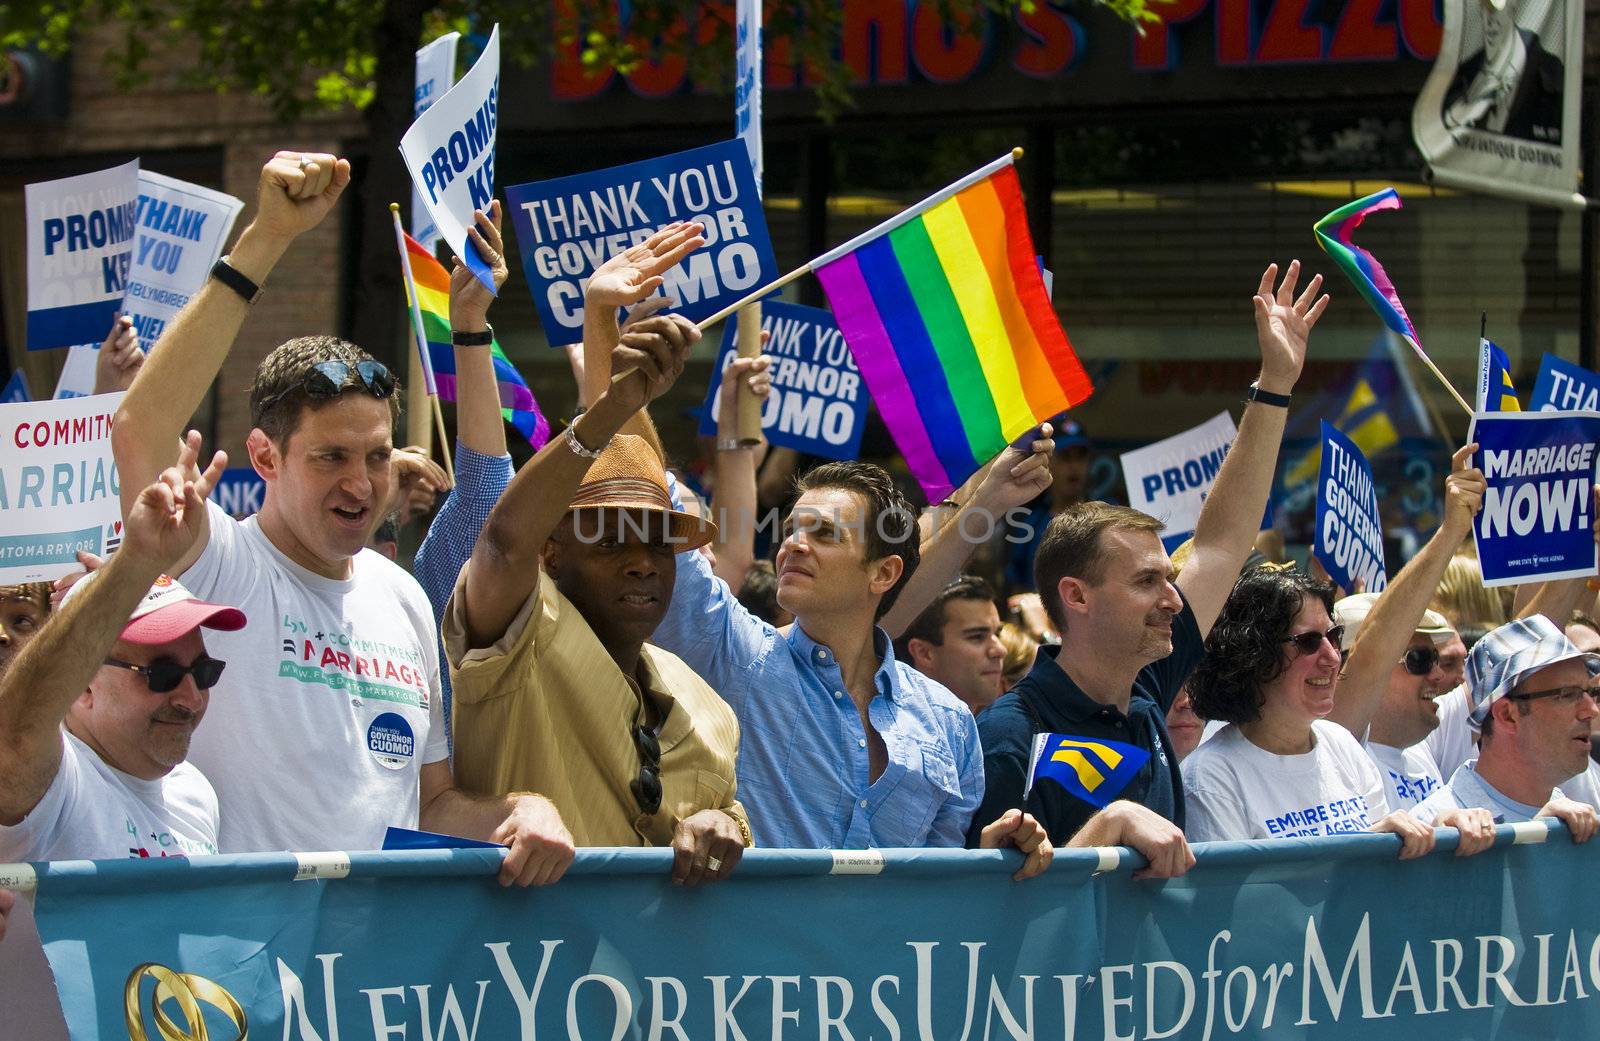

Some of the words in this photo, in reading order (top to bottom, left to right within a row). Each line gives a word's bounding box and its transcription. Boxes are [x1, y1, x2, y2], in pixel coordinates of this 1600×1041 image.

[421, 73, 498, 205] PROMIS
[467, 148, 496, 210] KE
[521, 181, 650, 243] THANK
[651, 160, 738, 217] YOU
[44, 199, 136, 256] PROMIS
[134, 194, 208, 242] THANK
[534, 206, 749, 280] GOVEROR
[136, 235, 184, 275] YOU
[547, 242, 761, 328] CMO
[732, 315, 810, 358] ANK
[722, 350, 860, 402] ERNOR
[711, 385, 855, 446] OMO
[1328, 438, 1372, 515] THANK
[1484, 443, 1595, 478] MARRIAGE
[1326, 477, 1385, 569] GOVERNO
[1481, 478, 1589, 540] NOW!
[303, 639, 425, 687] MARRIAGE
[370, 731, 412, 745] GOVERNOR
[370, 739, 412, 756] CUOMO!
[371, 725, 388, 733] THANK
[1265, 805, 1329, 834] EMPIRE
[484, 940, 902, 1041] YORKERS
[906, 941, 1196, 1041] UNIED
[1202, 929, 1294, 1041] for
